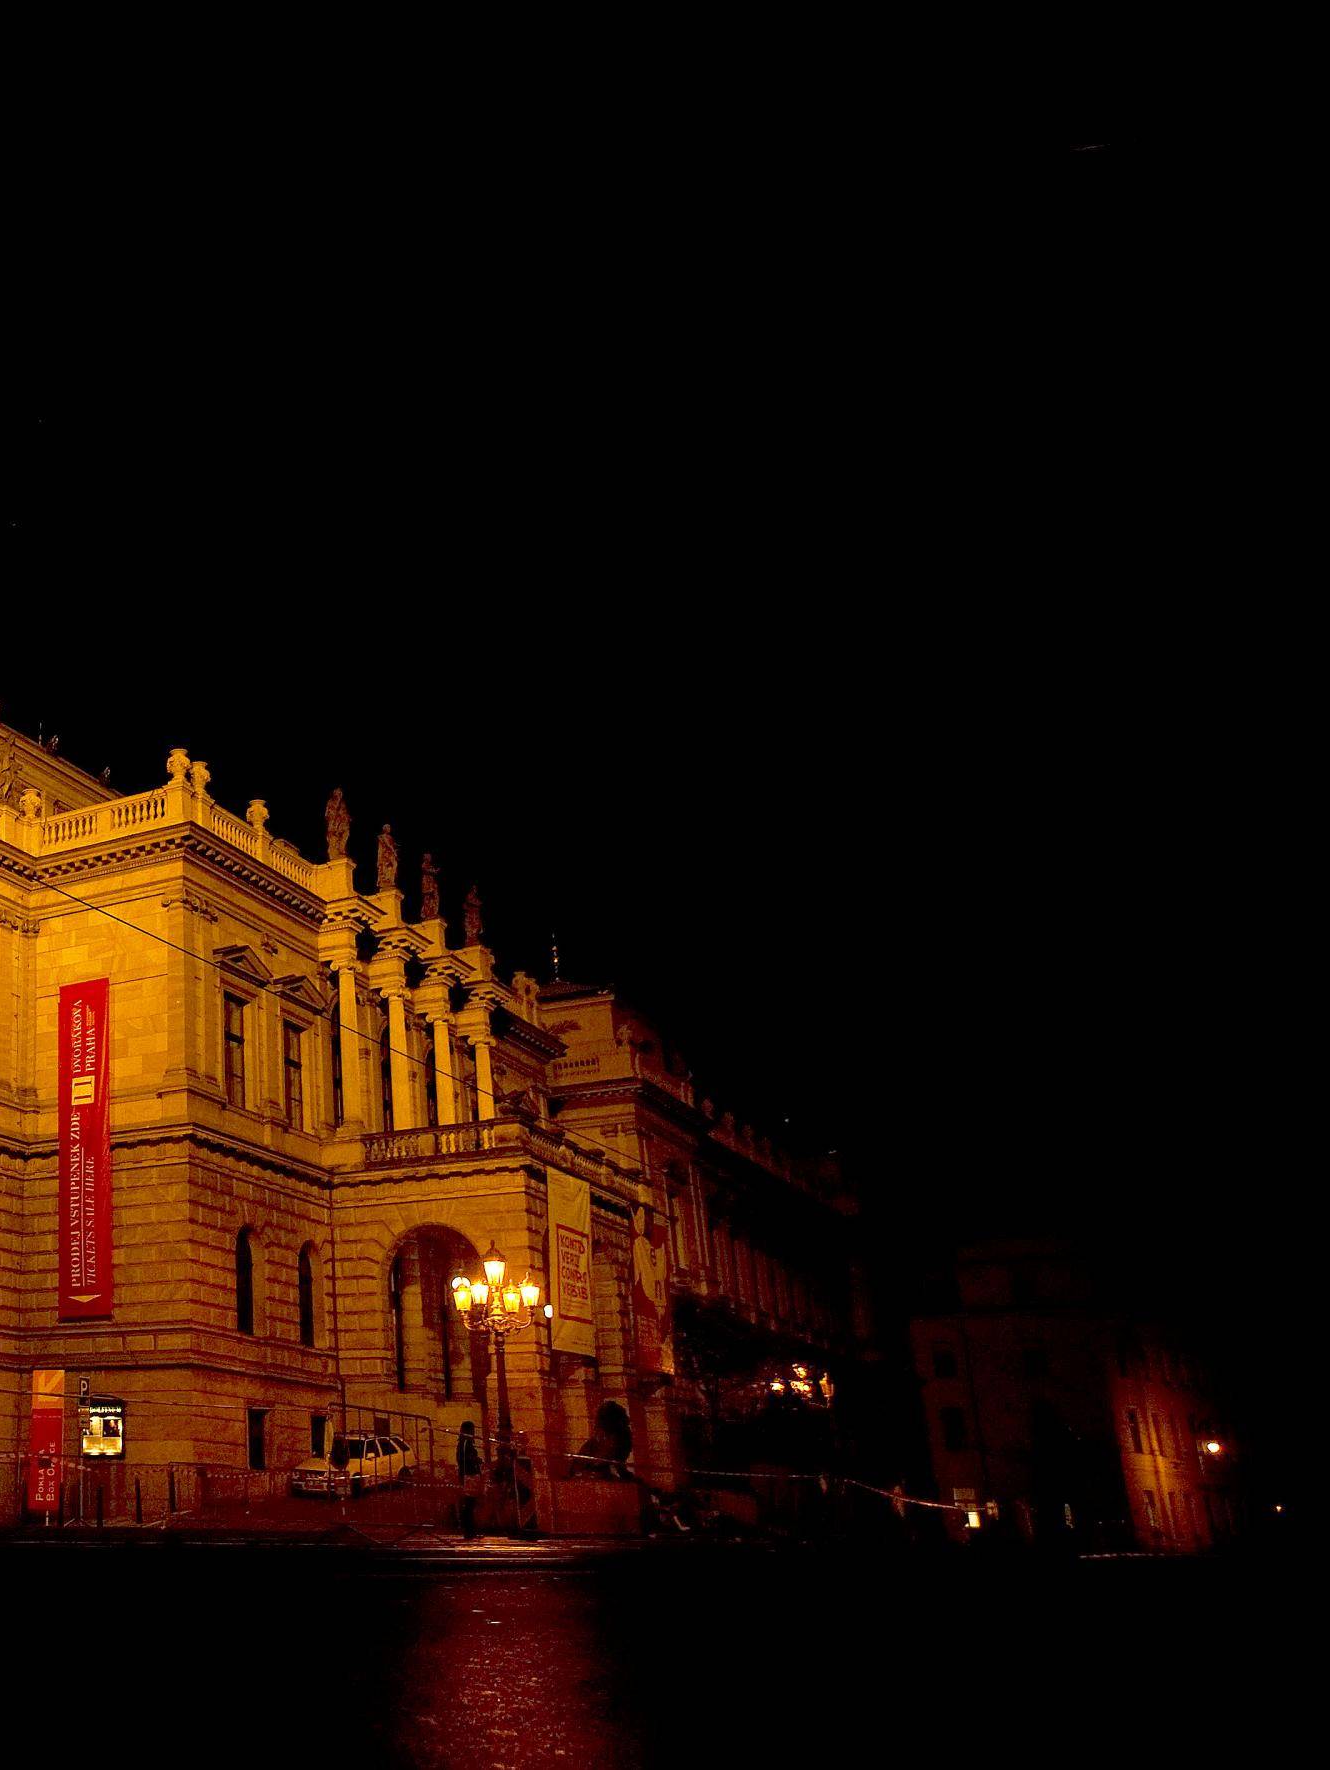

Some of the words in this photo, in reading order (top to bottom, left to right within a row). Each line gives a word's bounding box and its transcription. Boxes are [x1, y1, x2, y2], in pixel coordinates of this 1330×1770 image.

[86, 1028, 95, 1072] PRAHA
[70, 1112, 80, 1140] ZDE
[70, 1143, 80, 1227] VSTUPENEK
[85, 1156, 95, 1191] HERE
[71, 1231, 81, 1287] PRODEJ
[85, 1231, 96, 1286] TICKETS
[80, 1380, 88, 1397] P
[35, 1449, 45, 1501] POKLAA
[47, 1441, 56, 1476] OFCE
